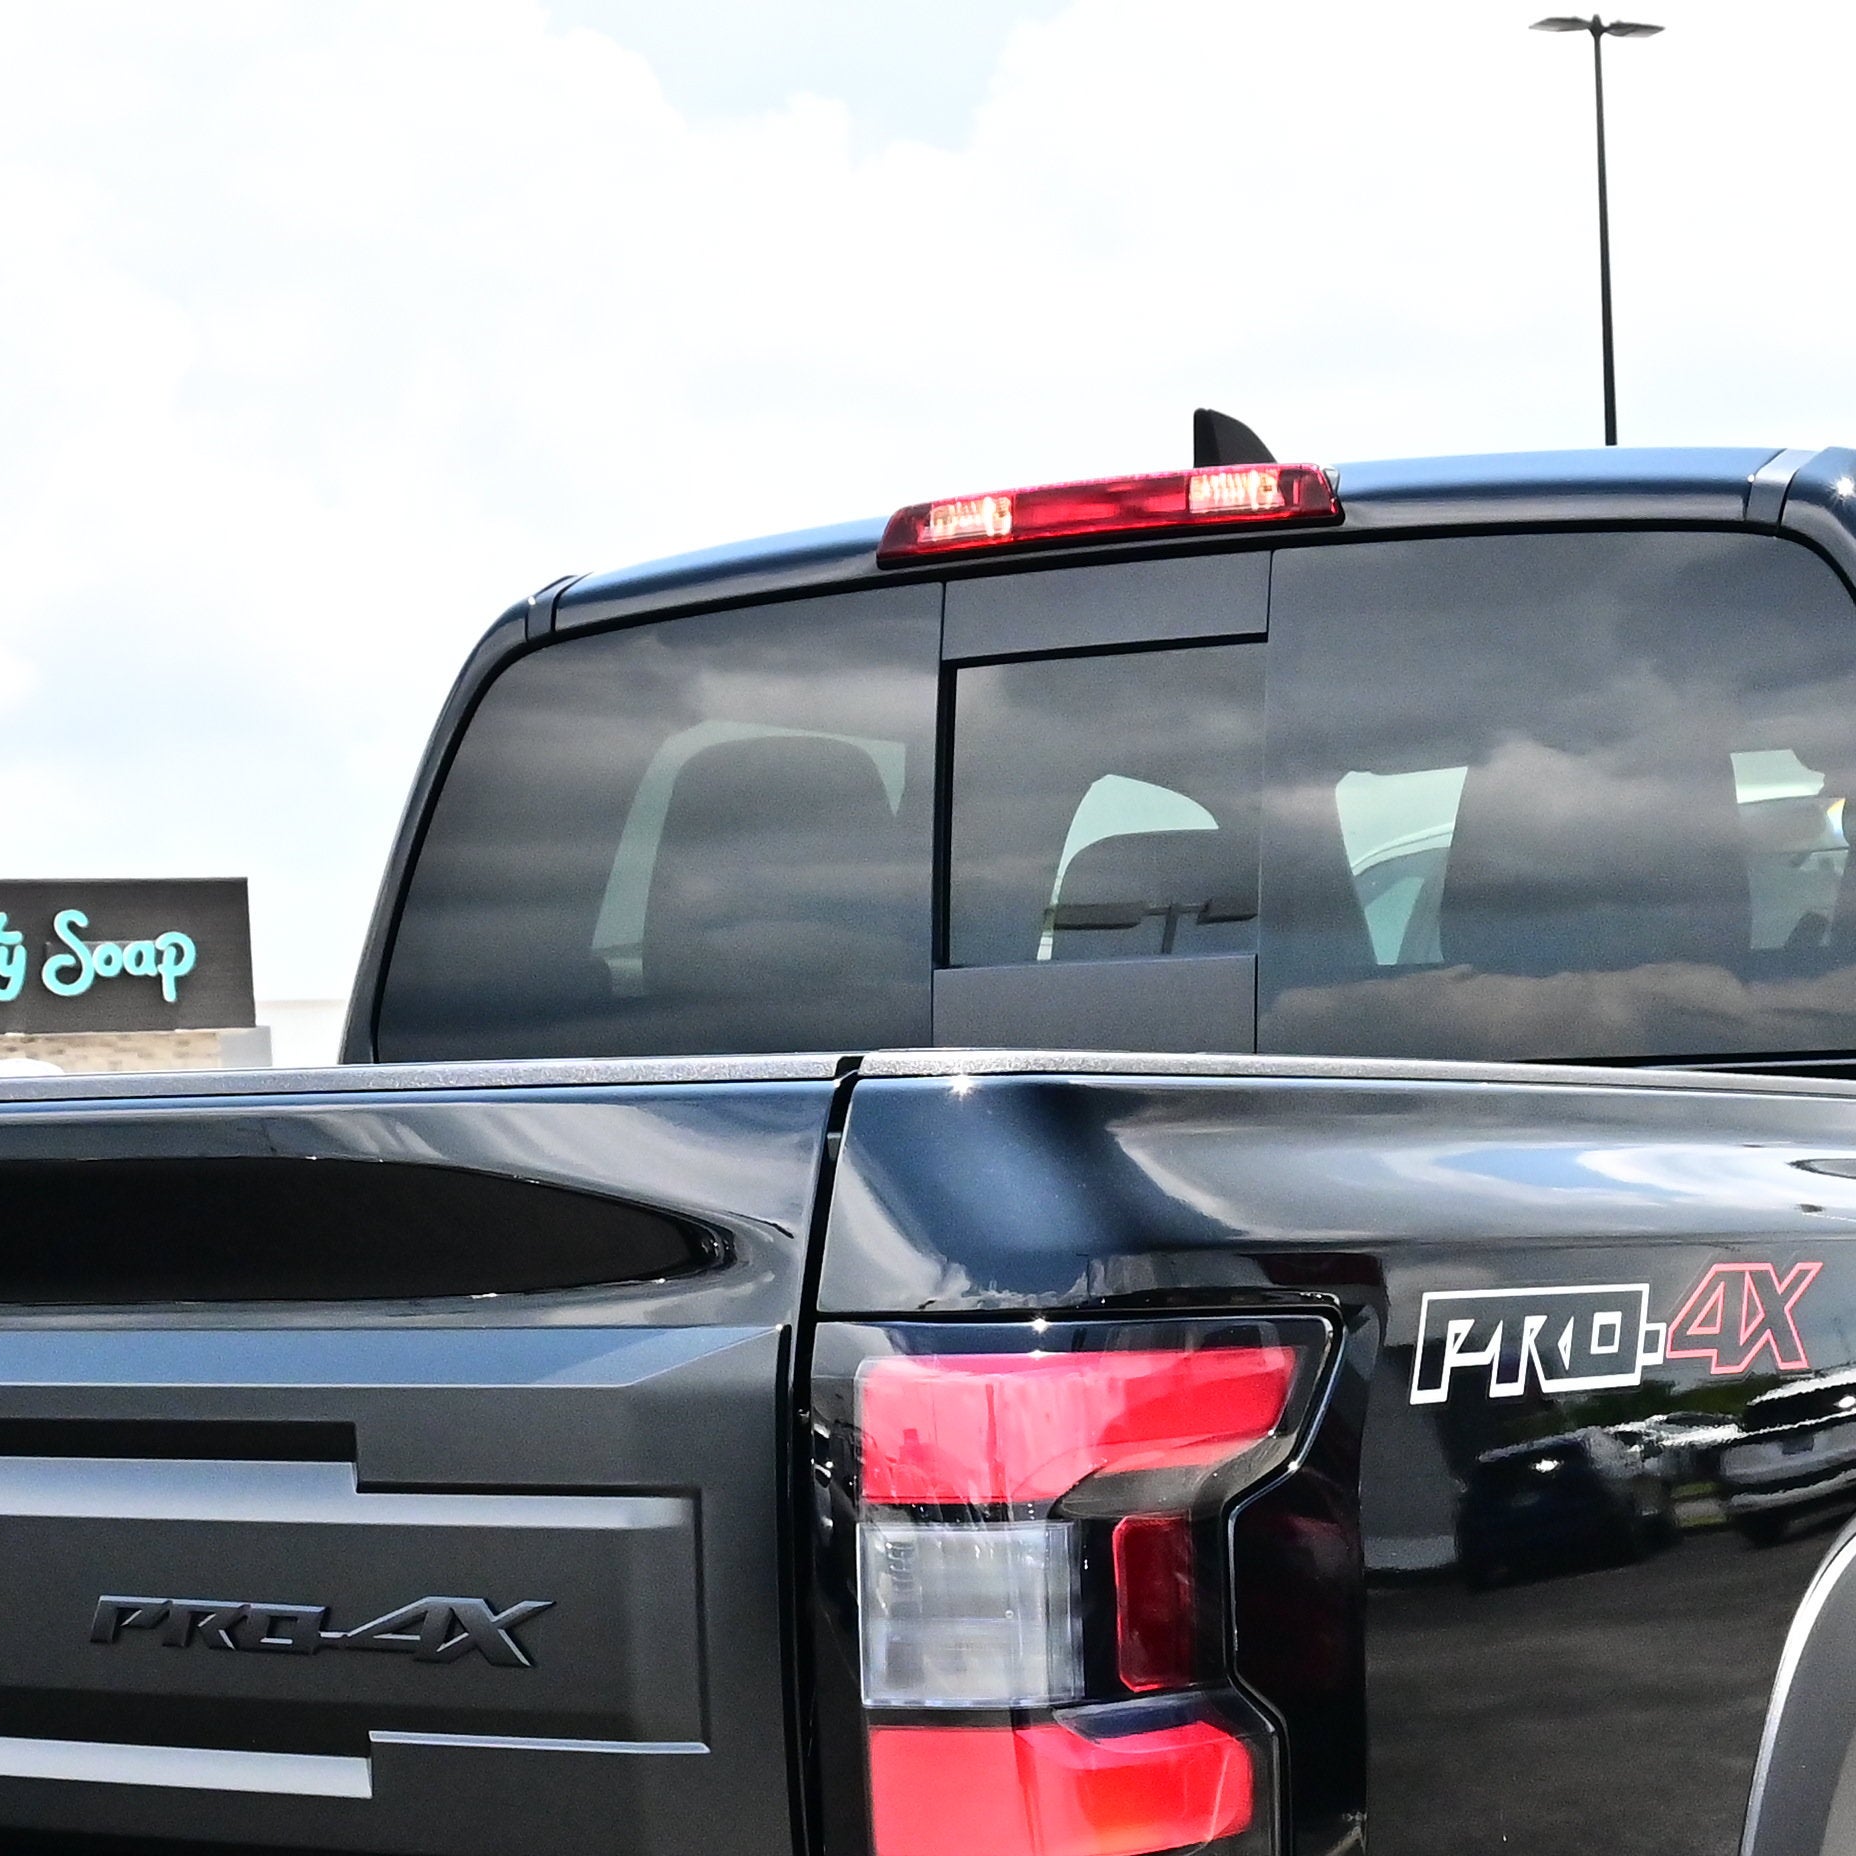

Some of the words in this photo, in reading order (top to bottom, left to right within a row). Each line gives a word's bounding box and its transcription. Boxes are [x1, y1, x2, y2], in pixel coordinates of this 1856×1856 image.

[41, 909, 196, 1003] Soap
[1410, 1262, 1824, 1405] PRO-4X
[89, 1594, 557, 1668] PRO-4X
